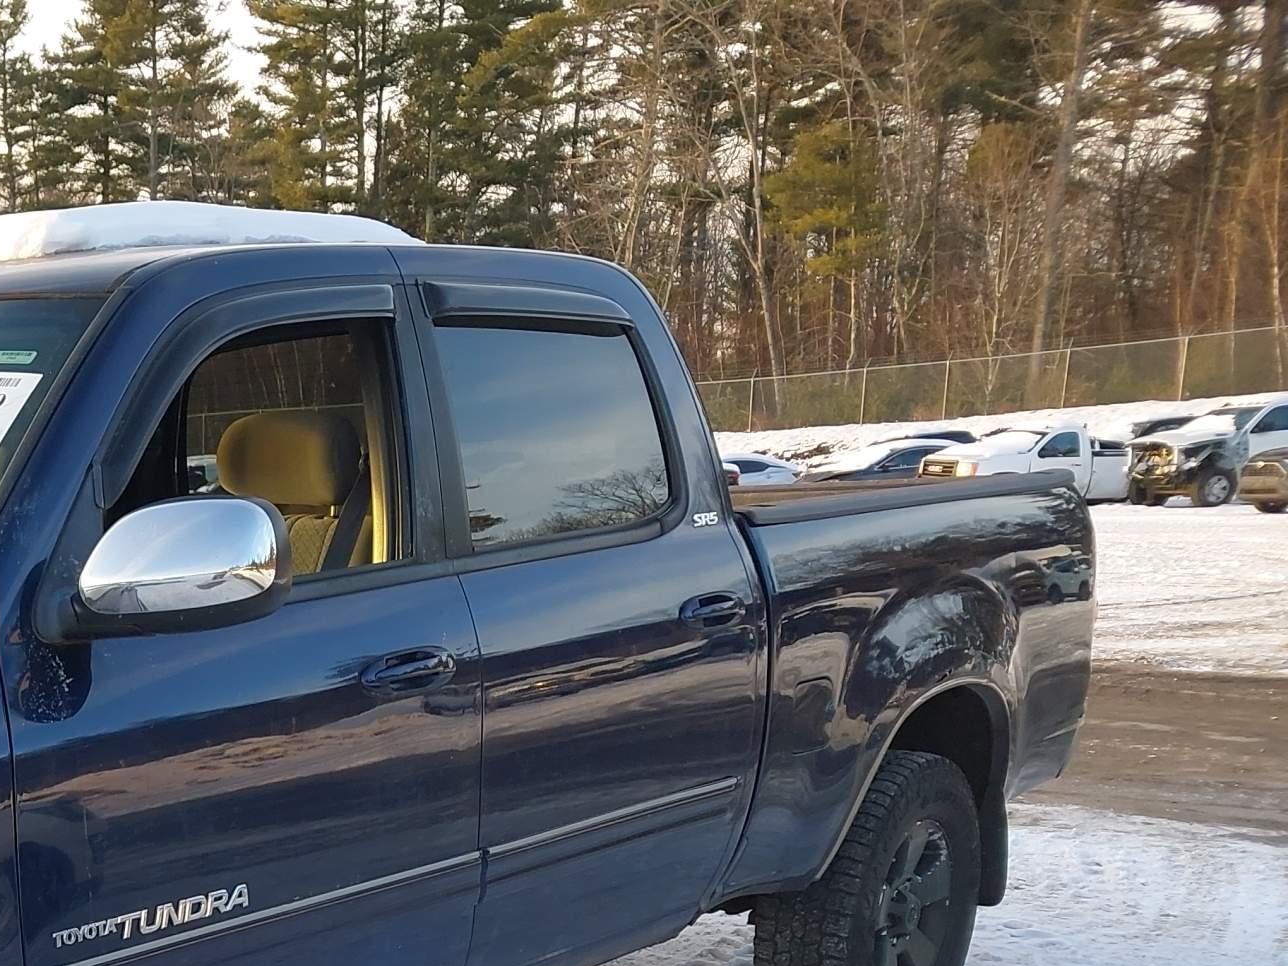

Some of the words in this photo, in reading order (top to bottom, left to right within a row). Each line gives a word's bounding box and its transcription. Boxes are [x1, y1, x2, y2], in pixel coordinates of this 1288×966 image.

[692, 511, 719, 527] SR5
[52, 916, 117, 948] TOYOTA
[117, 883, 250, 939] TUNDRA
